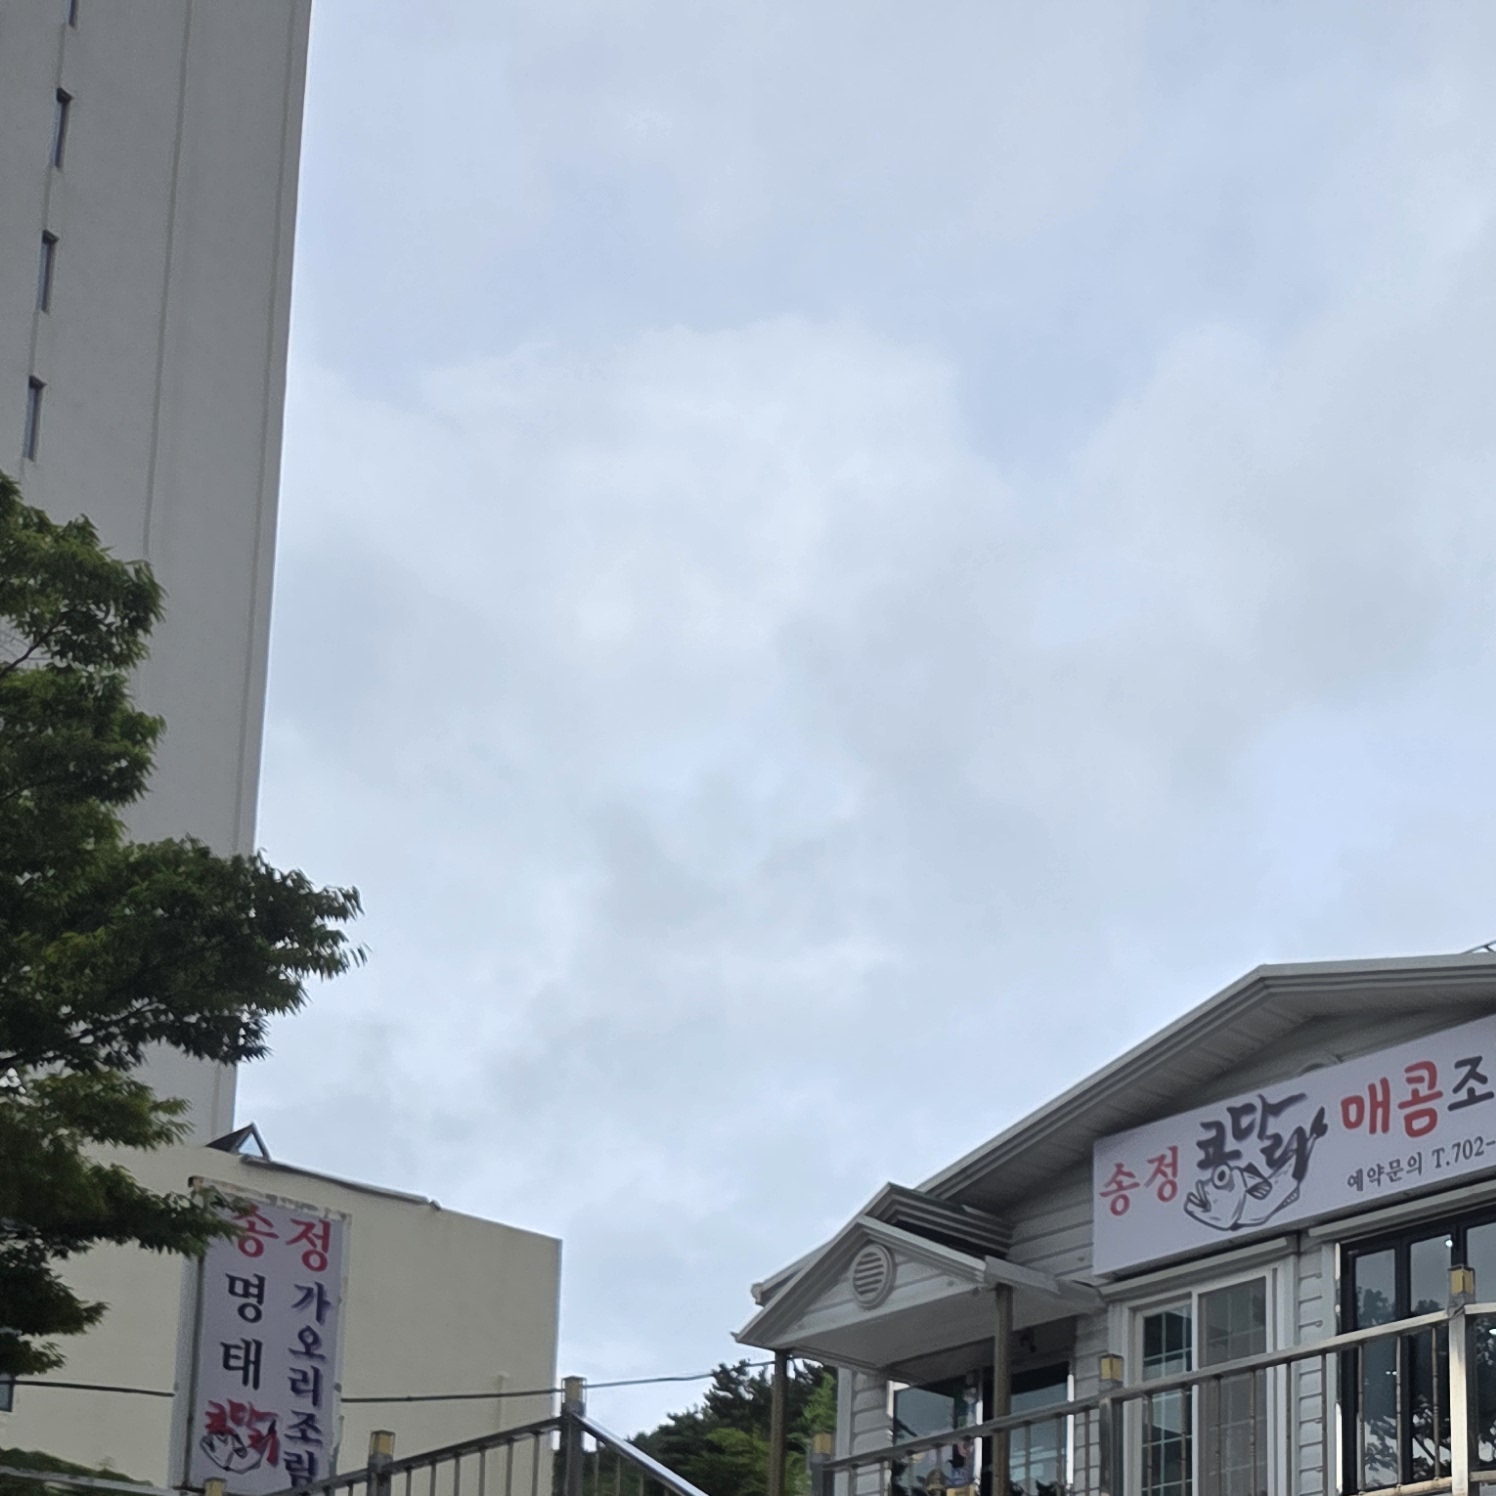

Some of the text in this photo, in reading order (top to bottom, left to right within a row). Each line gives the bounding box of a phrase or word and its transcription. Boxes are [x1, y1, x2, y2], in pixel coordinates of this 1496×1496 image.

[1100, 1145, 1180, 1217] 송정
[1346, 1151, 1423, 1192] 예약문의
[220, 1273, 266, 1390] 명태
